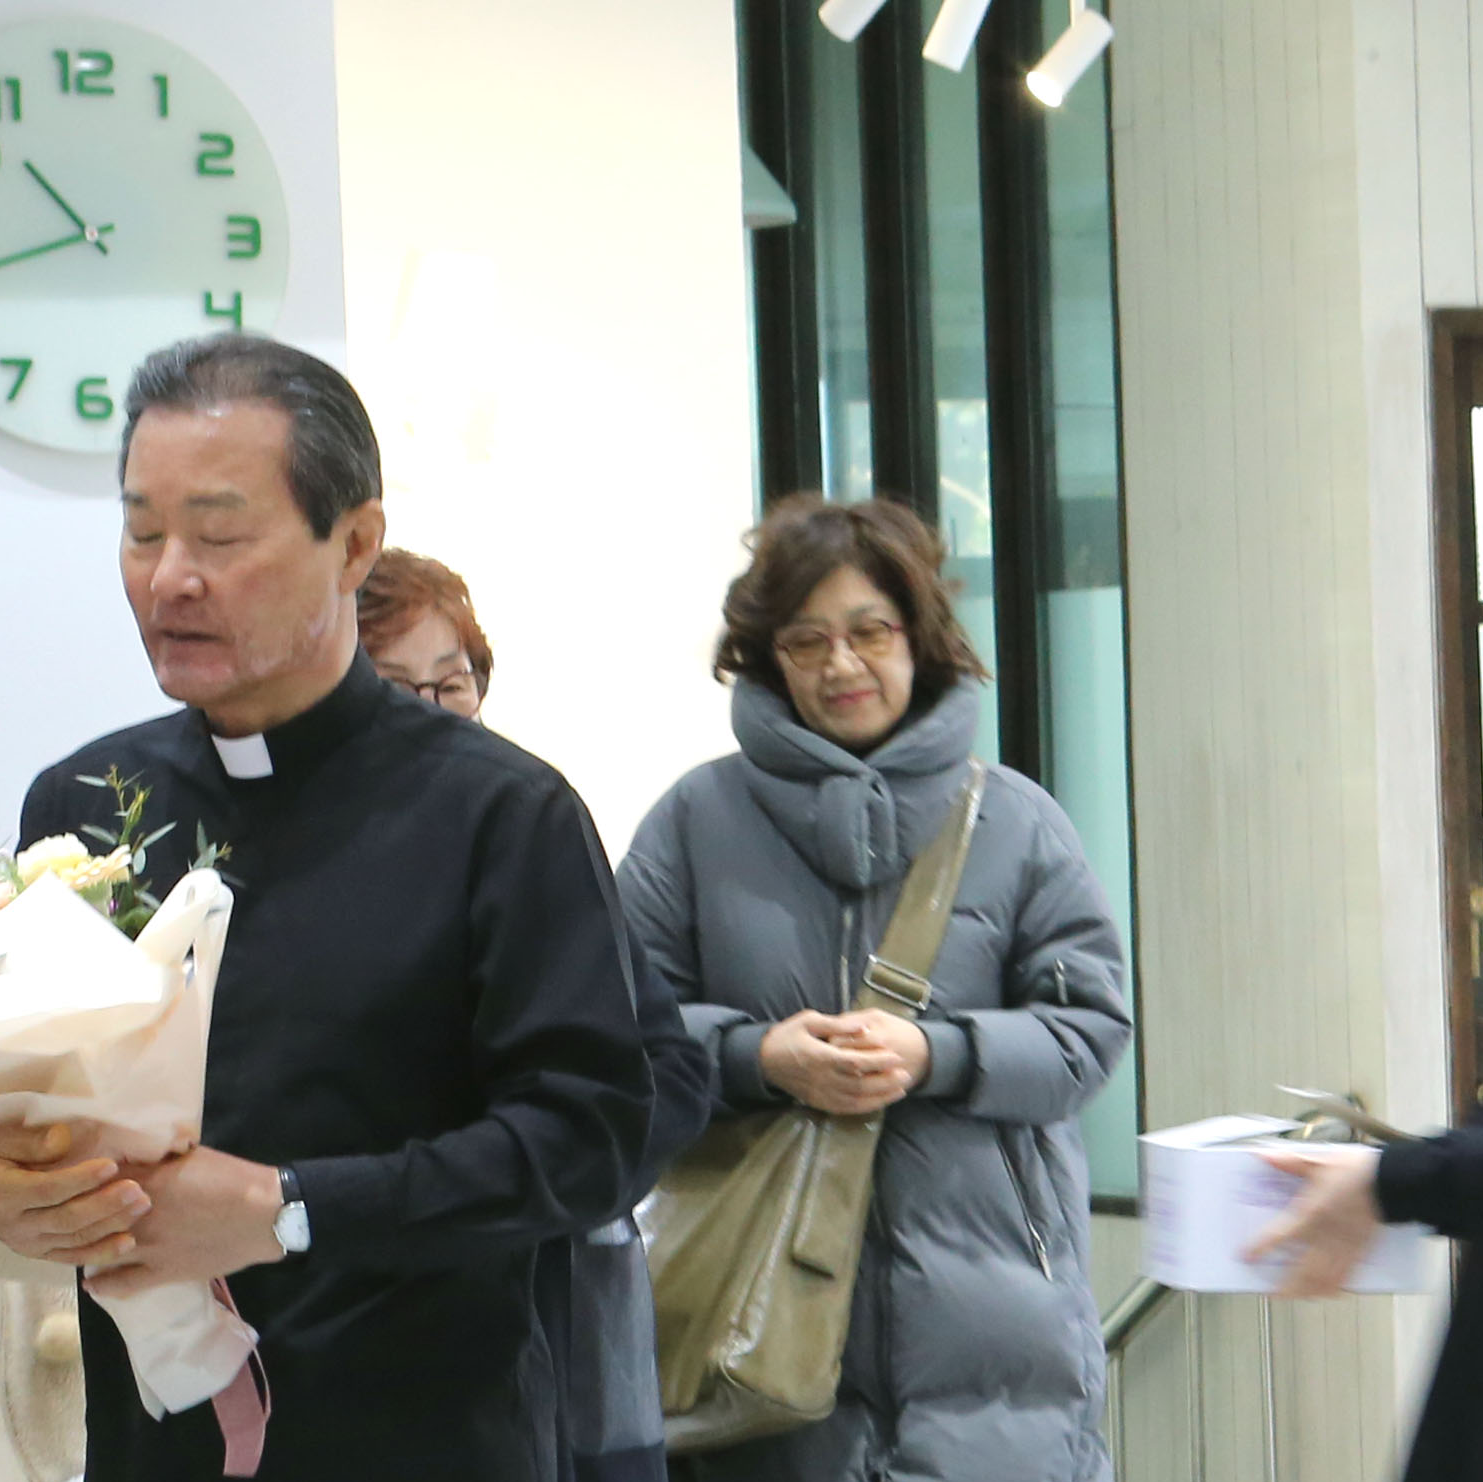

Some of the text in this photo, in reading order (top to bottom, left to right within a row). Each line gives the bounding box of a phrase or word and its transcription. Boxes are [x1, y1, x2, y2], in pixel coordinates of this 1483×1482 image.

[53, 50, 115, 94] 12
[152, 74, 169, 118] 1
[197, 133, 234, 176] 2
[227, 215, 262, 259] 3
[204, 291, 242, 331] 4
[0, 358, 33, 400] 7
[75, 377, 114, 420] 6
